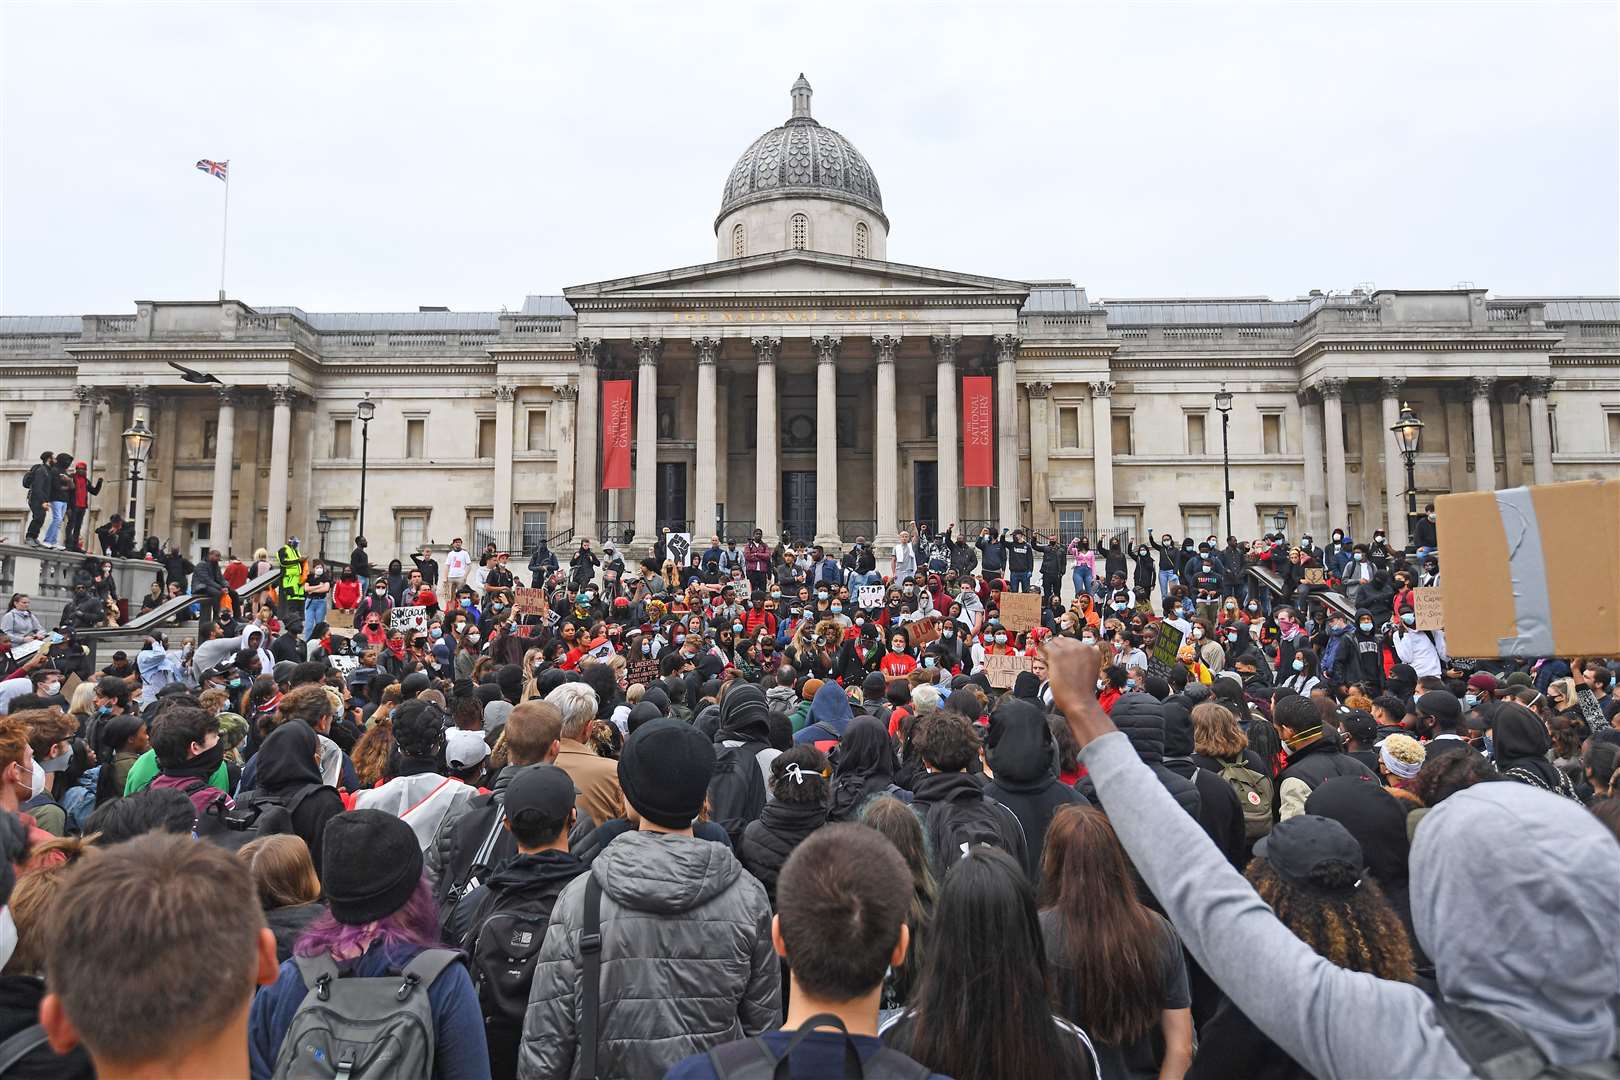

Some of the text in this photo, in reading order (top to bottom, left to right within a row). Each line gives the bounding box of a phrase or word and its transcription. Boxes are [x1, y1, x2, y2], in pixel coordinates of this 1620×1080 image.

[611, 396, 619, 448] NATIONAL
[619, 397, 628, 448] GALLERY
[971, 393, 979, 445] NATIONAL
[980, 394, 989, 446] GALLERY
[861, 586, 882, 594] STOP
[391, 617, 411, 628] IS NOT
[912, 619, 935, 639] BLM
